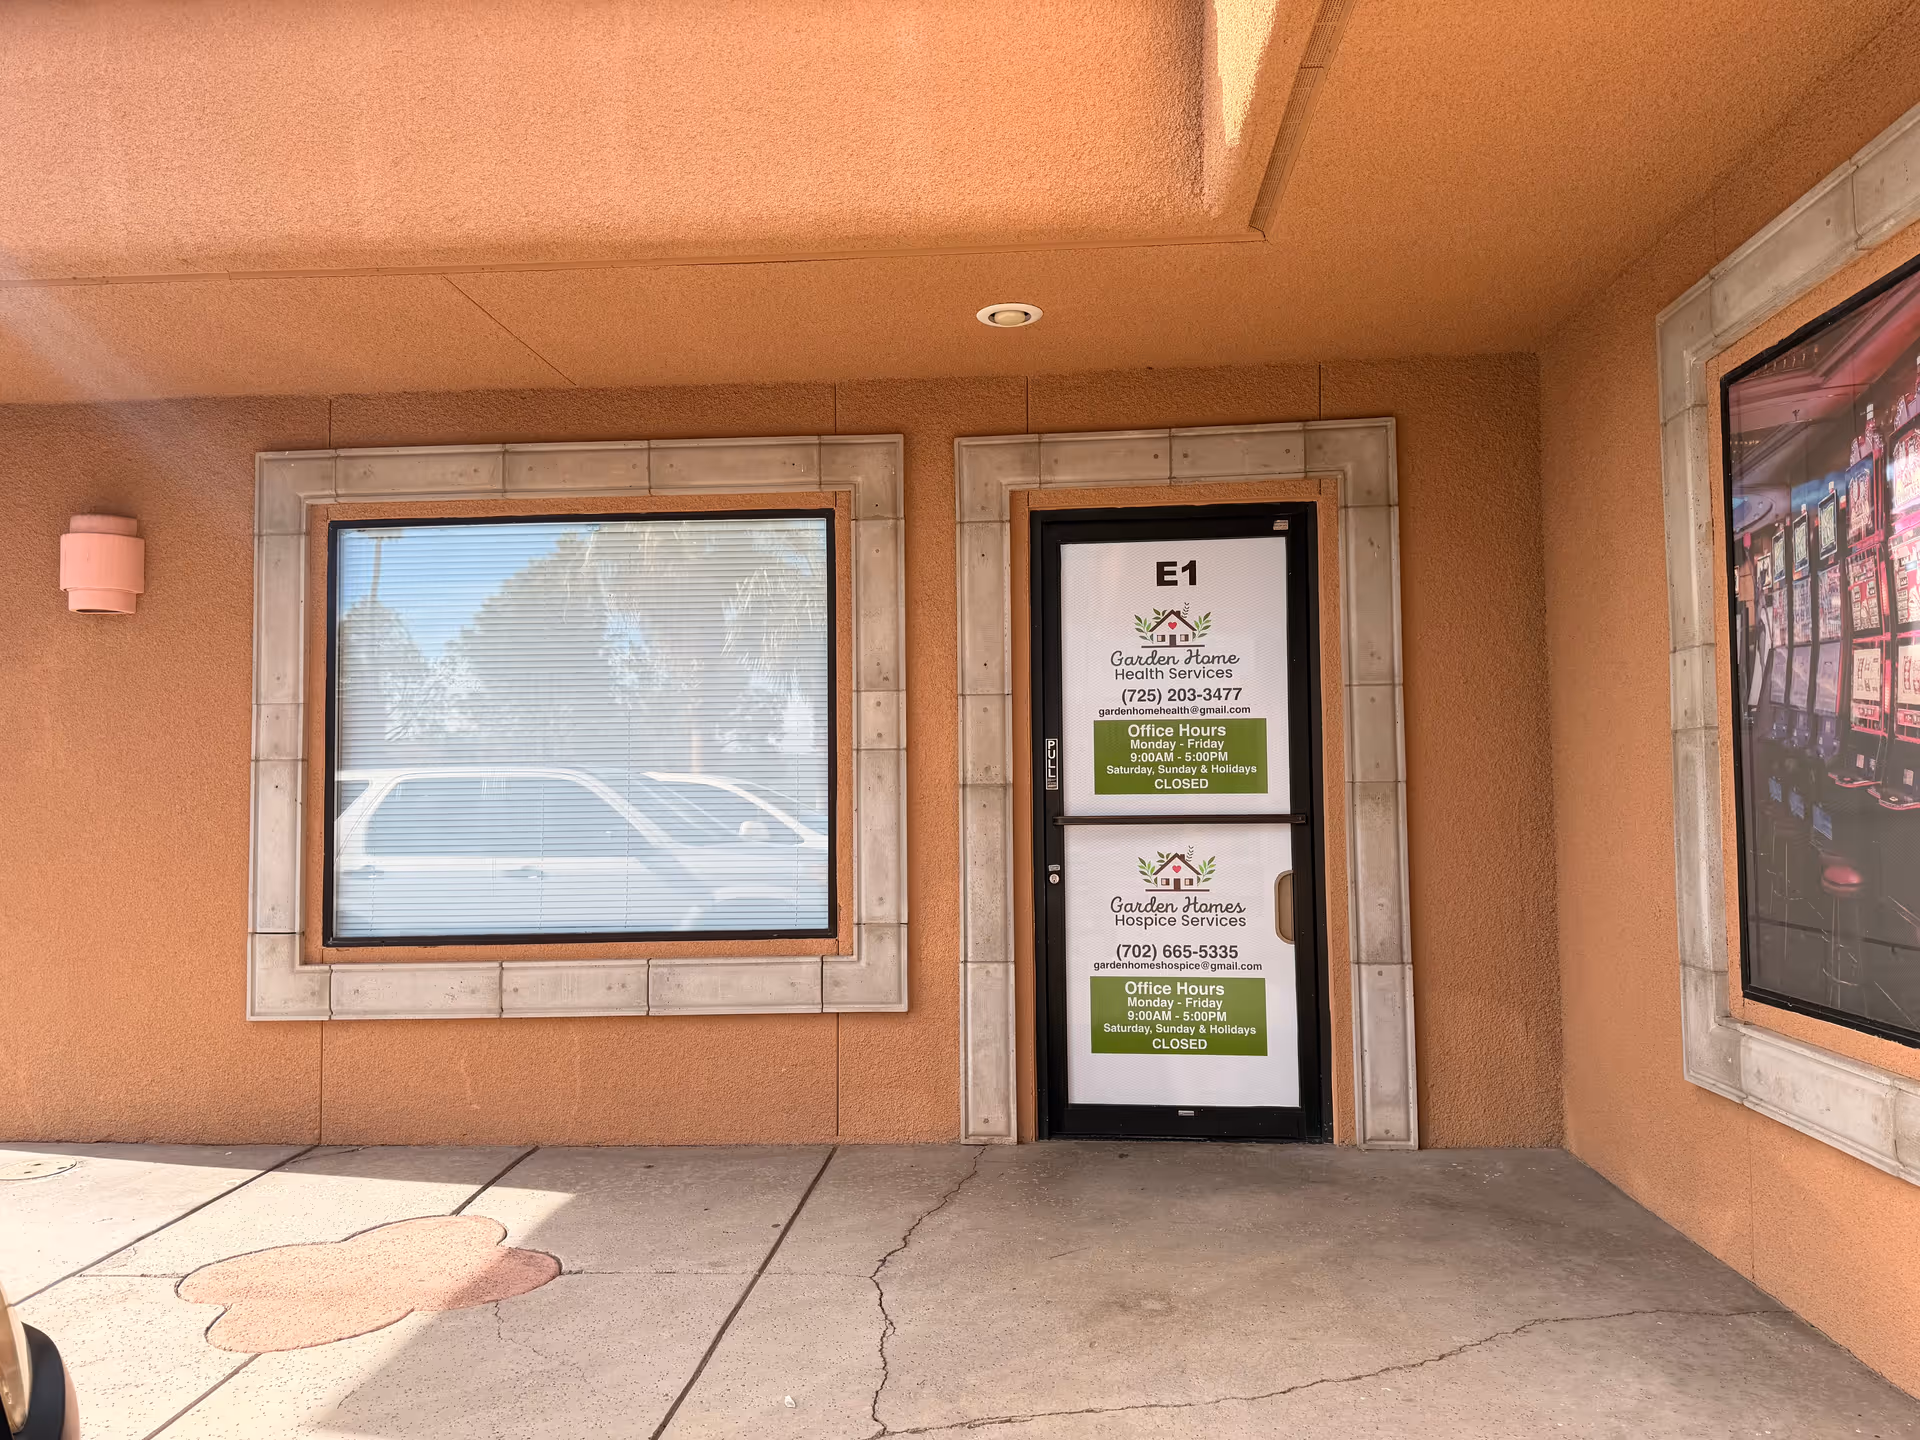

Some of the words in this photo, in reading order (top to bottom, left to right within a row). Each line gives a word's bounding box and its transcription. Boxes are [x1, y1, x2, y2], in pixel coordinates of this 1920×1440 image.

[1156, 560, 1197, 586] E1
[1110, 650, 1179, 666] Garden
[1184, 649, 1240, 665] Home
[1115, 668, 1164, 680] Health
[1169, 667, 1233, 679] Services
[1121, 689, 1162, 705] (725)
[1167, 688, 1242, 702] 203-3477
[1098, 705, 1251, 717] gardenhomehealth@gmail.com
[1128, 725, 1174, 737] Office
[1179, 724, 1226, 736] Hours
[1130, 740, 1176, 751] Monday
[1187, 739, 1224, 749] Friday
[1047, 740, 1056, 778] PULL
[1130, 752, 1174, 762] 9:00AM
[1185, 752, 1228, 762] 5:00PM
[1106, 765, 1155, 776] Saturday,
[1158, 765, 1197, 775] Sunday
[1200, 765, 1208, 773] &
[1211, 764, 1257, 774] Holidays
[1155, 779, 1208, 789] CLOSED
[1110, 897, 1178, 913] Garden
[1182, 897, 1246, 913] Homes
[1115, 914, 1177, 929] Hospice
[1182, 915, 1247, 926] Services
[1116, 944, 1157, 961] (702)
[1163, 945, 1238, 959] 665-5335
[1094, 960, 1262, 972] gardenhomeshospice@gmail.com
[1125, 981, 1172, 995] Office
[1177, 983, 1225, 996] Hours
[1127, 997, 1174, 1009] Monday
[1186, 998, 1223, 1010] Friday
[1127, 1011, 1172, 1021] 9:00AM
[1183, 1011, 1227, 1022] 5:00PM
[1104, 1024, 1152, 1034] Saturday,
[1156, 1024, 1196, 1035] Sunday
[1199, 1025, 1206, 1033] &
[1210, 1025, 1256, 1036] Holidays
[1152, 1038, 1207, 1050] CLOSED
